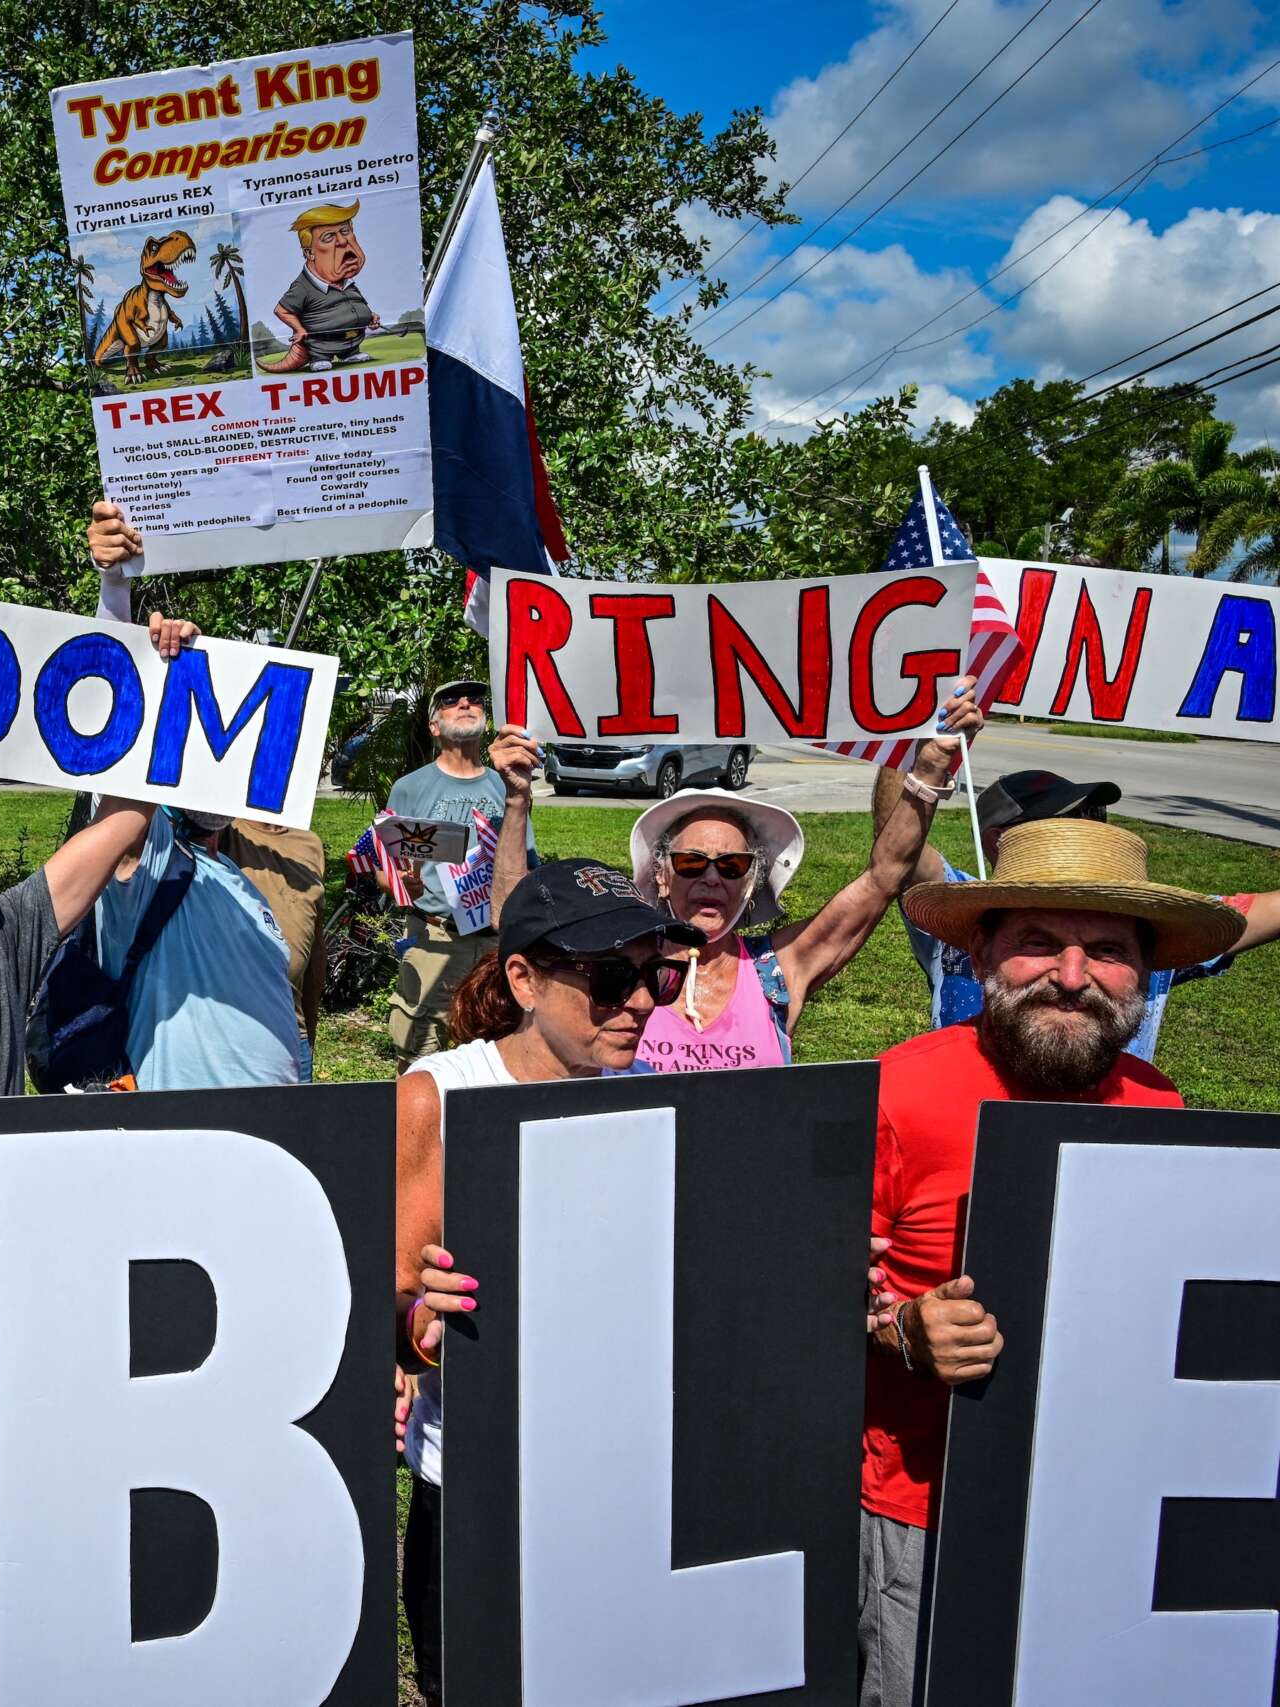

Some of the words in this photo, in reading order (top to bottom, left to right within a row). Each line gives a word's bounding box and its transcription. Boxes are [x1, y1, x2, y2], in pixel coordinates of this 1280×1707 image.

[68, 74, 240, 144] Tyrant
[255, 57, 380, 112] King
[94, 115, 367, 186] Comparison
[243, 164, 353, 191] Tyrannosaurus
[357, 153, 414, 170] Deretro
[259, 186, 313, 206] (Tyrant
[317, 177, 363, 194] Lizard
[367, 170, 400, 187] Ass)
[74, 192, 178, 217] Tyrannosaurus
[182, 185, 213, 200] REX
[76, 216, 127, 234] (Tyrant
[130, 207, 173, 223] Lizard
[177, 202, 215, 217] King)
[102, 390, 225, 430] T-REX
[261, 367, 425, 411] T-RUMP
[211, 419, 259, 432] COMMON
[262, 416, 297, 426] Traits:
[112, 444, 144, 455] Large,
[146, 442, 163, 450] but
[166, 432, 254, 448] SMALL-BRAINED,
[257, 426, 296, 438] SWAMP
[299, 422, 347, 434] creature,
[350, 418, 370, 428] tiny
[372, 414, 405, 424] hands
[124, 451, 170, 463] VICIOUS,
[173, 442, 258, 458] COLD-BLOODED,
[261, 433, 339, 448] DESTRUCTIVE,
[341, 425, 397, 439] MINDLESS
[215, 452, 273, 466] DIFFERENT
[276, 449, 310, 459] Traits:
[315, 453, 341, 462] Alive
[344, 449, 373, 459] today
[108, 472, 144, 484] Extinct
[146, 472, 168, 480] 60m
[170, 469, 198, 479] years
[201, 466, 220, 475] ago
[309, 458, 386, 474] (unfortunately)
[286, 474, 318, 484] Found
[320, 473, 333, 481] on
[336, 471, 356, 481] golf
[358, 468, 400, 478] courses
[121, 480, 182, 494] (fortunately)
[320, 481, 369, 492] Cowardly
[110, 494, 140, 504] Found
[143, 492, 153, 501] in
[155, 490, 191, 501] jungles
[321, 491, 365, 502] Criminal
[129, 503, 172, 513] Fearless
[277, 508, 300, 517] Best
[303, 503, 333, 514] friend
[336, 502, 346, 511] of
[358, 497, 409, 511] pedophile
[131, 513, 165, 523] Animal
[146, 522, 170, 532] hung
[172, 519, 194, 529] with
[197, 515, 251, 528] pedophiles
[505, 576, 961, 738] RING
[995, 567, 1153, 722] IN
[1176, 594, 1278, 723] A
[400, 842, 434, 854] NO
[448, 860, 469, 879] NO
[460, 885, 491, 909] SINC
[641, 1039, 673, 1056] NO
[678, 1043, 756, 1067] KINGS
